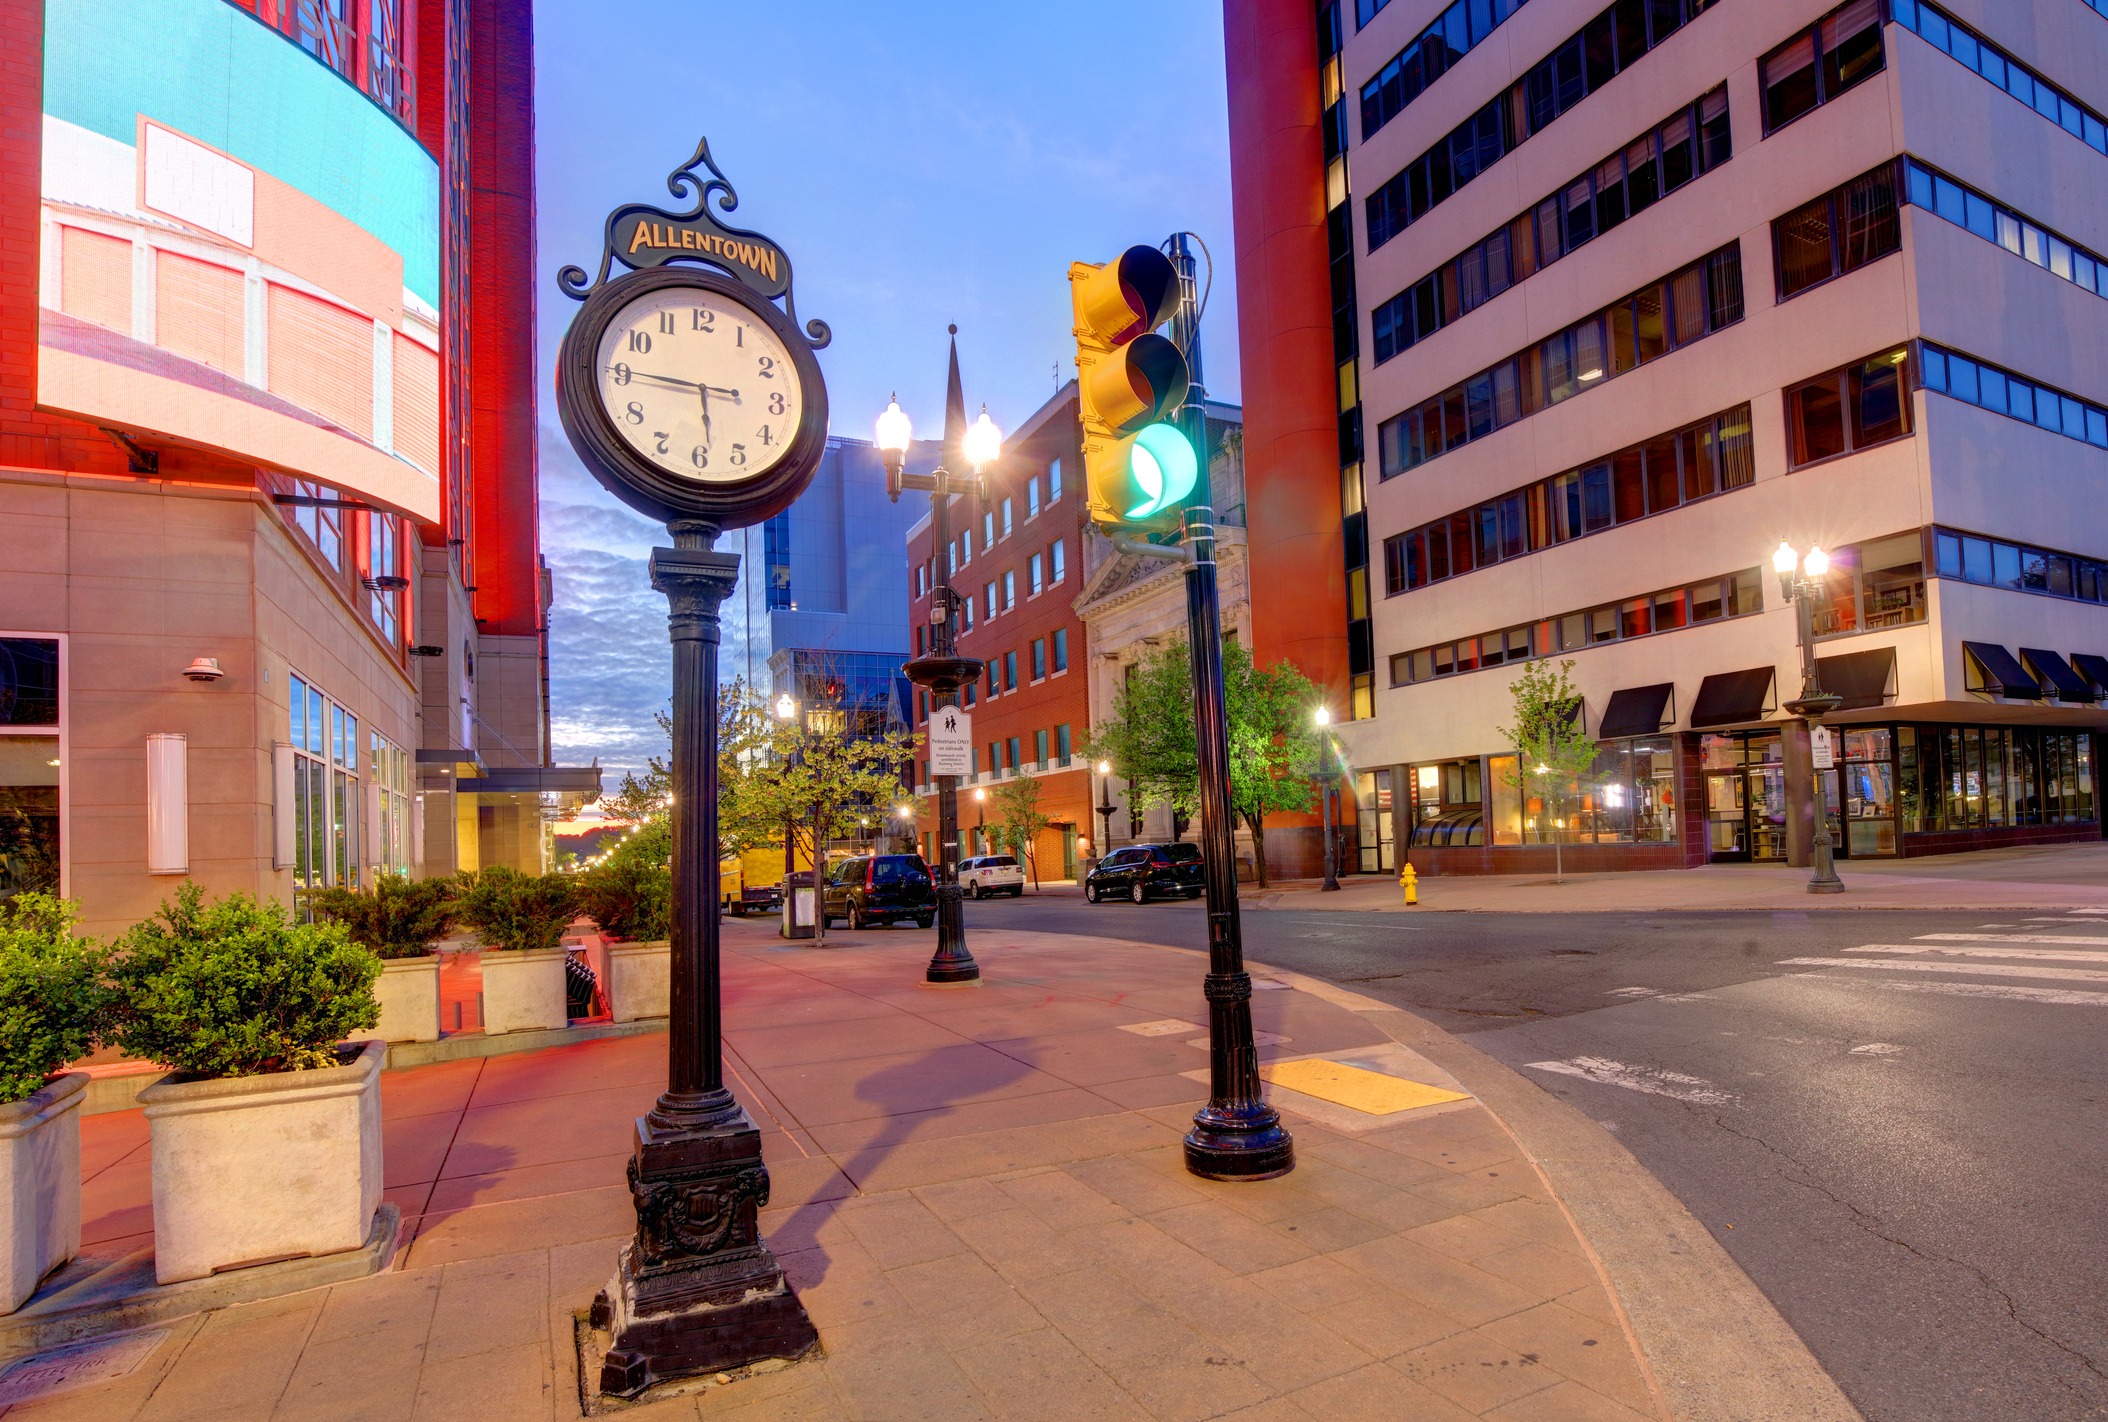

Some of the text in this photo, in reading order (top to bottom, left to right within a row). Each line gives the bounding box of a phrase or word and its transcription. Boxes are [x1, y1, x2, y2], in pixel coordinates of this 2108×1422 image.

[629, 220, 776, 283] ALLENTOWN
[659, 311, 675, 335] 11
[692, 308, 715, 333] 12
[628, 329, 652, 354] 10
[736, 326, 744, 348] 1
[614, 362, 631, 386] 9
[758, 356, 774, 379] 2
[626, 401, 644, 425] 8
[768, 392, 785, 415] 3
[654, 431, 669, 454] 7
[755, 424, 773, 446] 4
[692, 445, 708, 468] 6
[730, 443, 746, 465] 5
